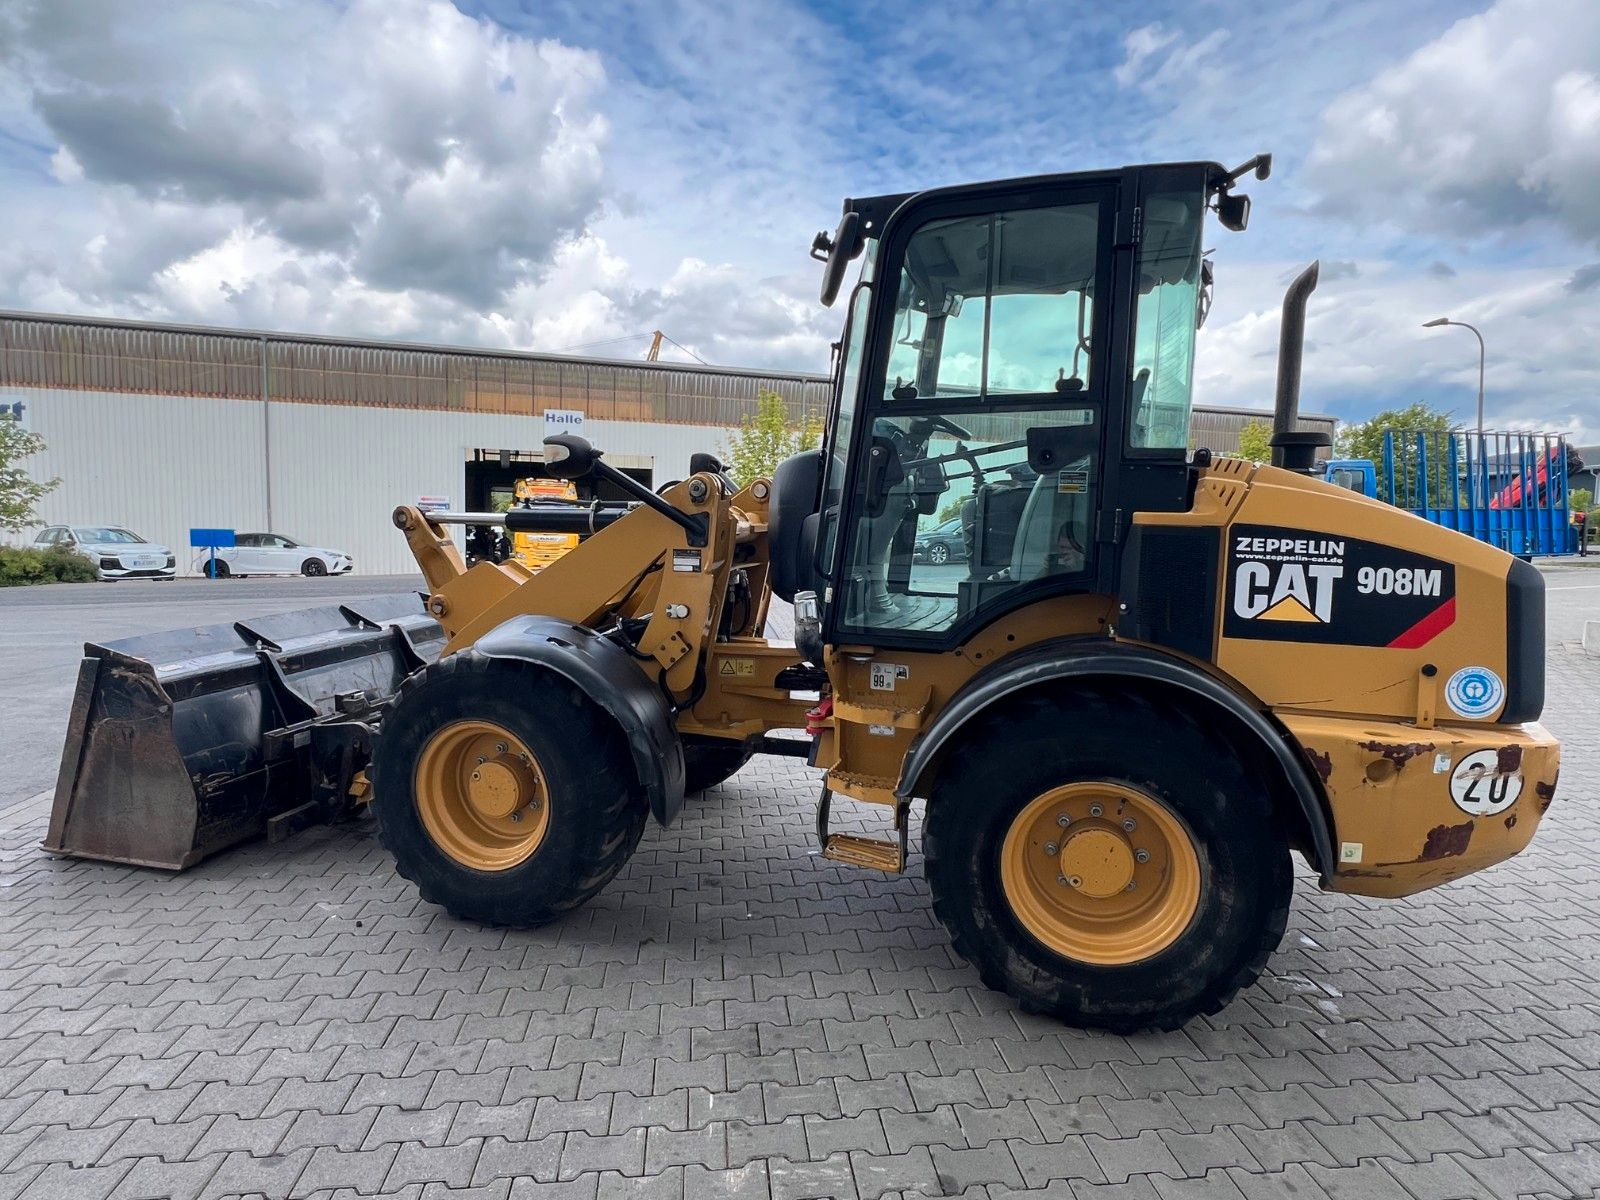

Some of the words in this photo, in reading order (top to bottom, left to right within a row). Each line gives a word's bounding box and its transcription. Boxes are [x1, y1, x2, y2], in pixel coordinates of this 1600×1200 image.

[545, 413, 583, 424] Halle
[1236, 537, 1345, 556] ZEPPELIN
[1235, 553, 1343, 564] www.zeppelin-cat.de
[1357, 566, 1442, 597] 908M
[1234, 561, 1344, 623] CAT
[873, 674, 885, 688] 99
[1463, 762, 1510, 804] 20
